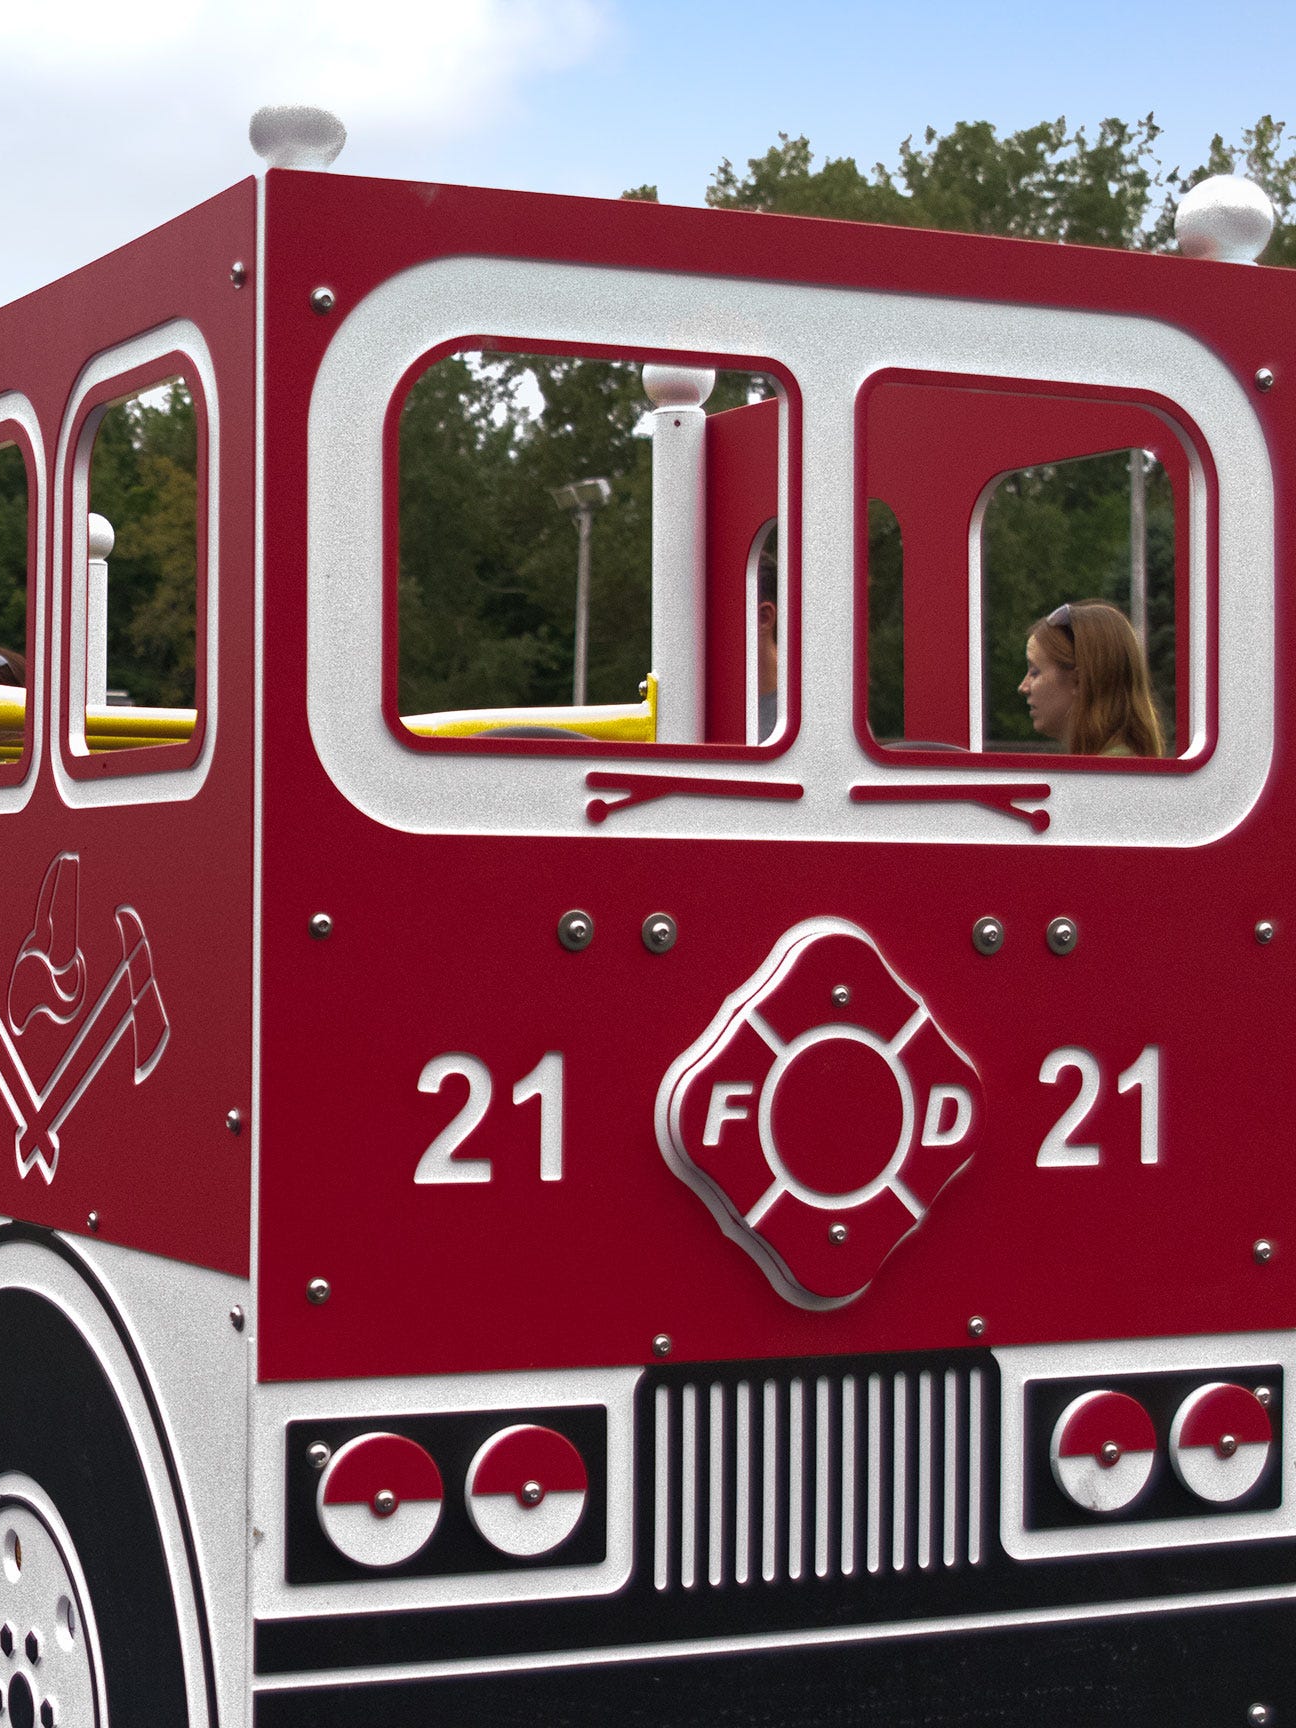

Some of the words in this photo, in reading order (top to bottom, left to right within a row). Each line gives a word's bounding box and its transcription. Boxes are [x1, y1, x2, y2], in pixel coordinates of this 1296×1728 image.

[413, 1053, 565, 1185] 21
[702, 1083, 755, 1147] F
[920, 1085, 974, 1147] D
[1035, 1045, 1161, 1169] 21
